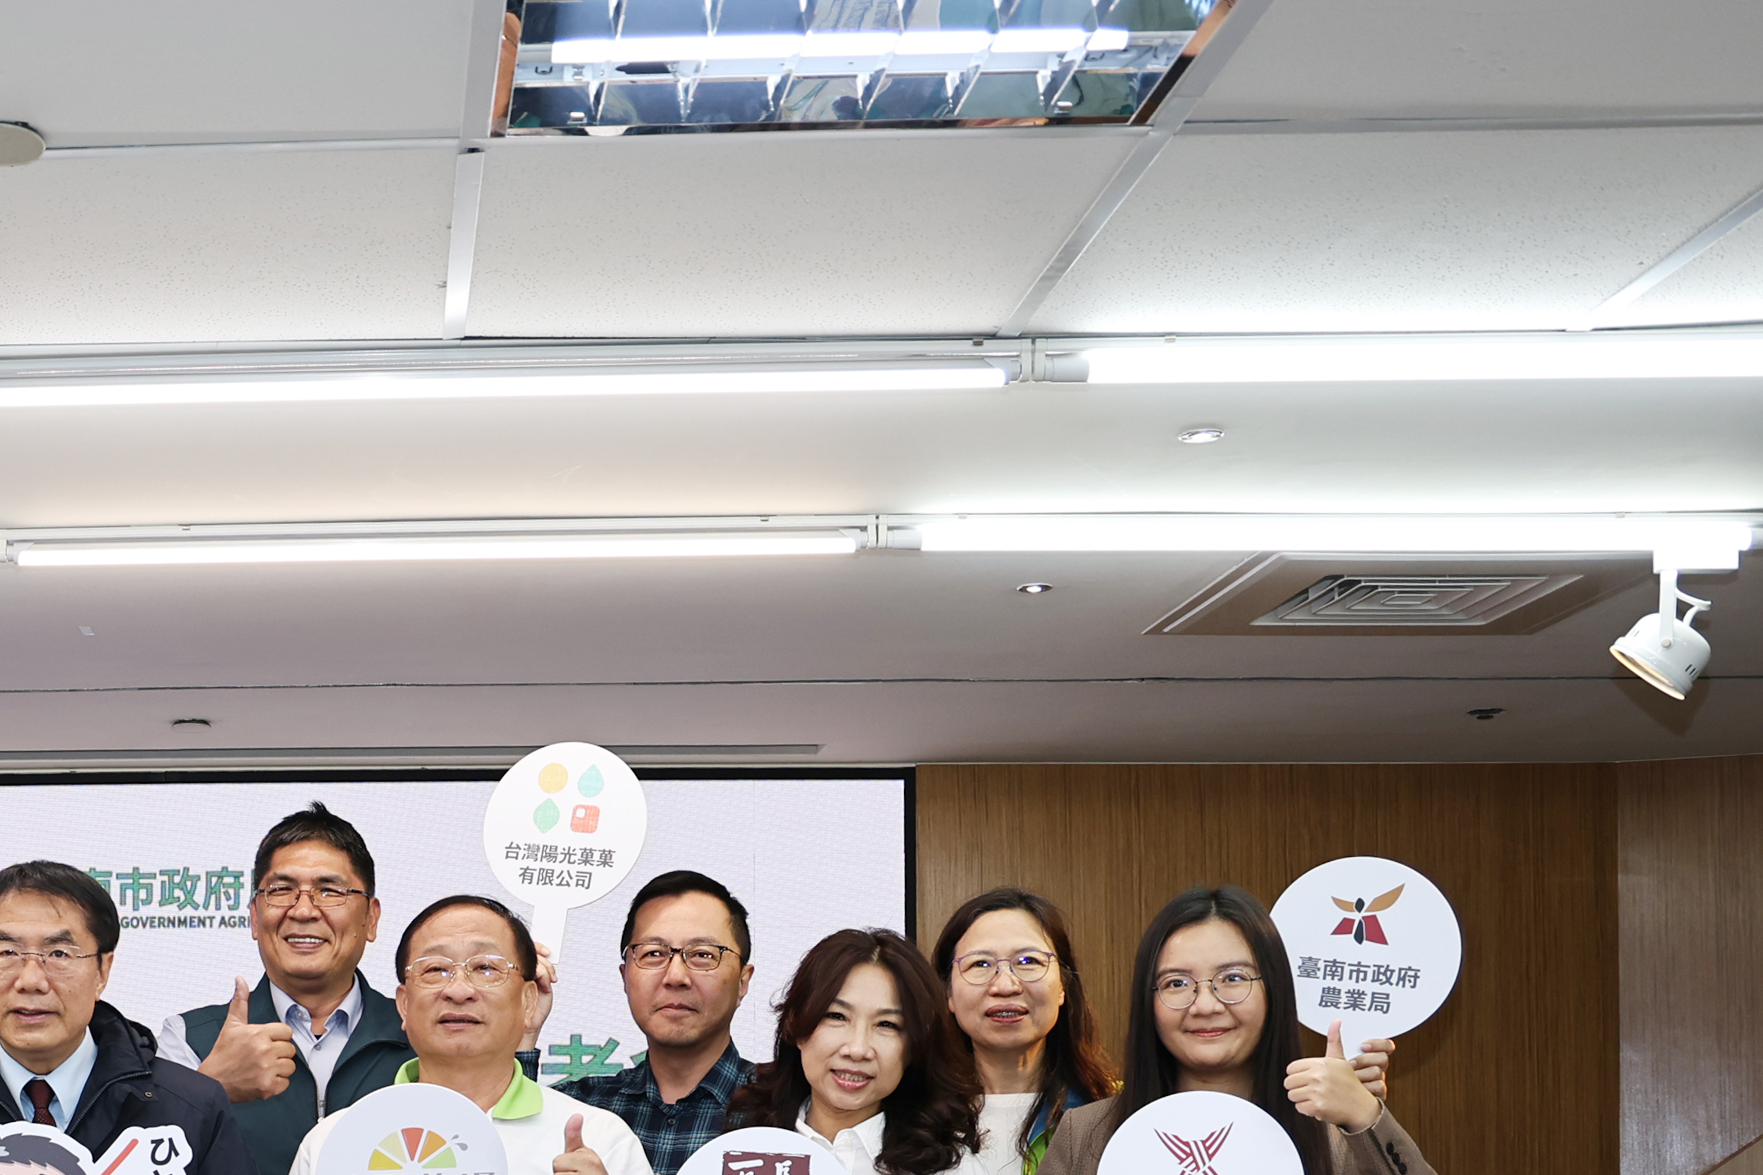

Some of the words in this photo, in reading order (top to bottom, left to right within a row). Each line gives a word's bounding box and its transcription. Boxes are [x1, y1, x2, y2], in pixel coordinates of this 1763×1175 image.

[503, 840, 616, 868] 台灣陽光菓菓
[83, 866, 255, 912] 市政府
[517, 866, 593, 891] 有限公司
[120, 915, 216, 929] GOVERNMENT
[219, 916, 252, 929] AGRI
[1296, 955, 1421, 991] 臺南市政府
[1318, 984, 1392, 1016] 農業局
